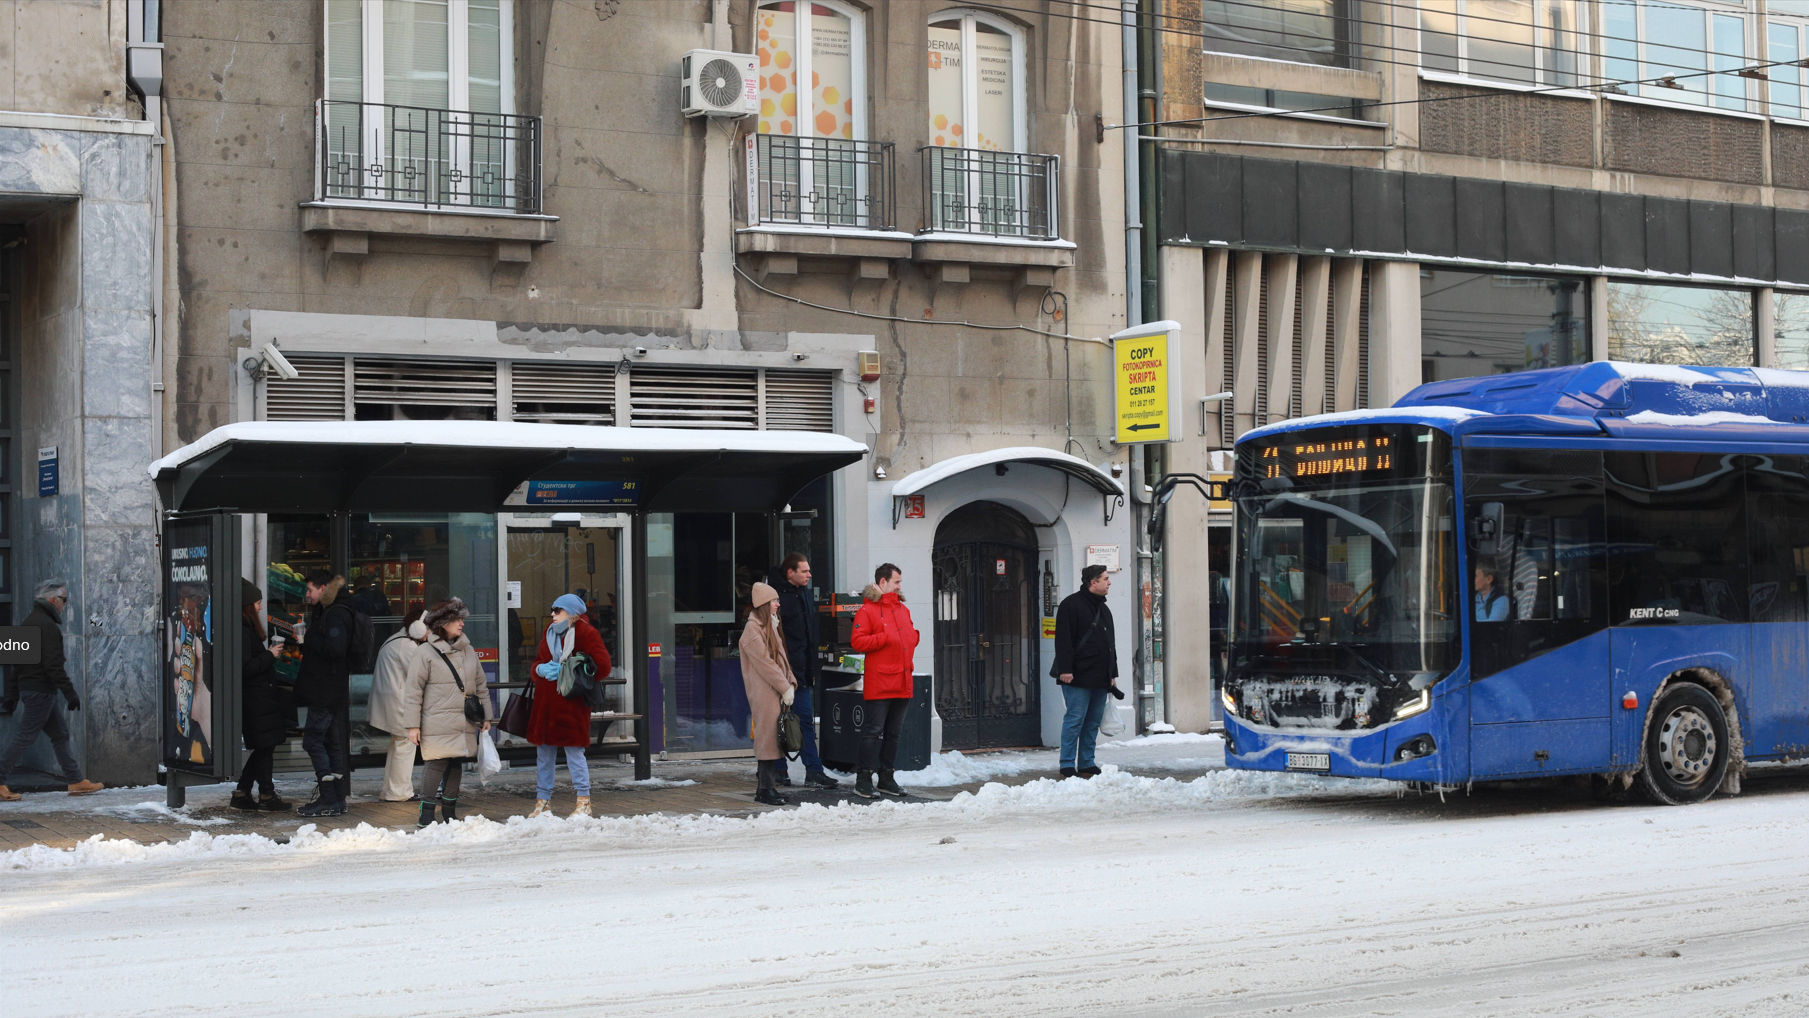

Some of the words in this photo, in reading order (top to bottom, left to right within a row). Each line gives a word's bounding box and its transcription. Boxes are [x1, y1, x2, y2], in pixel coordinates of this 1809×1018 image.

[976, 44, 1011, 52] DERMATOLOGIJA
[1130, 347, 1154, 360] COPY
[1122, 359, 1162, 372] FOTOKOPIRNICA
[1128, 371, 1157, 384] SKRIPTA
[1129, 385, 1156, 395] CENTAR
[622, 482, 636, 490] 581
[1629, 607, 1656, 619] KENT
[1656, 606, 1664, 618] C
[1664, 609, 1680, 617] CNG
[1289, 754, 1298, 766] BG
